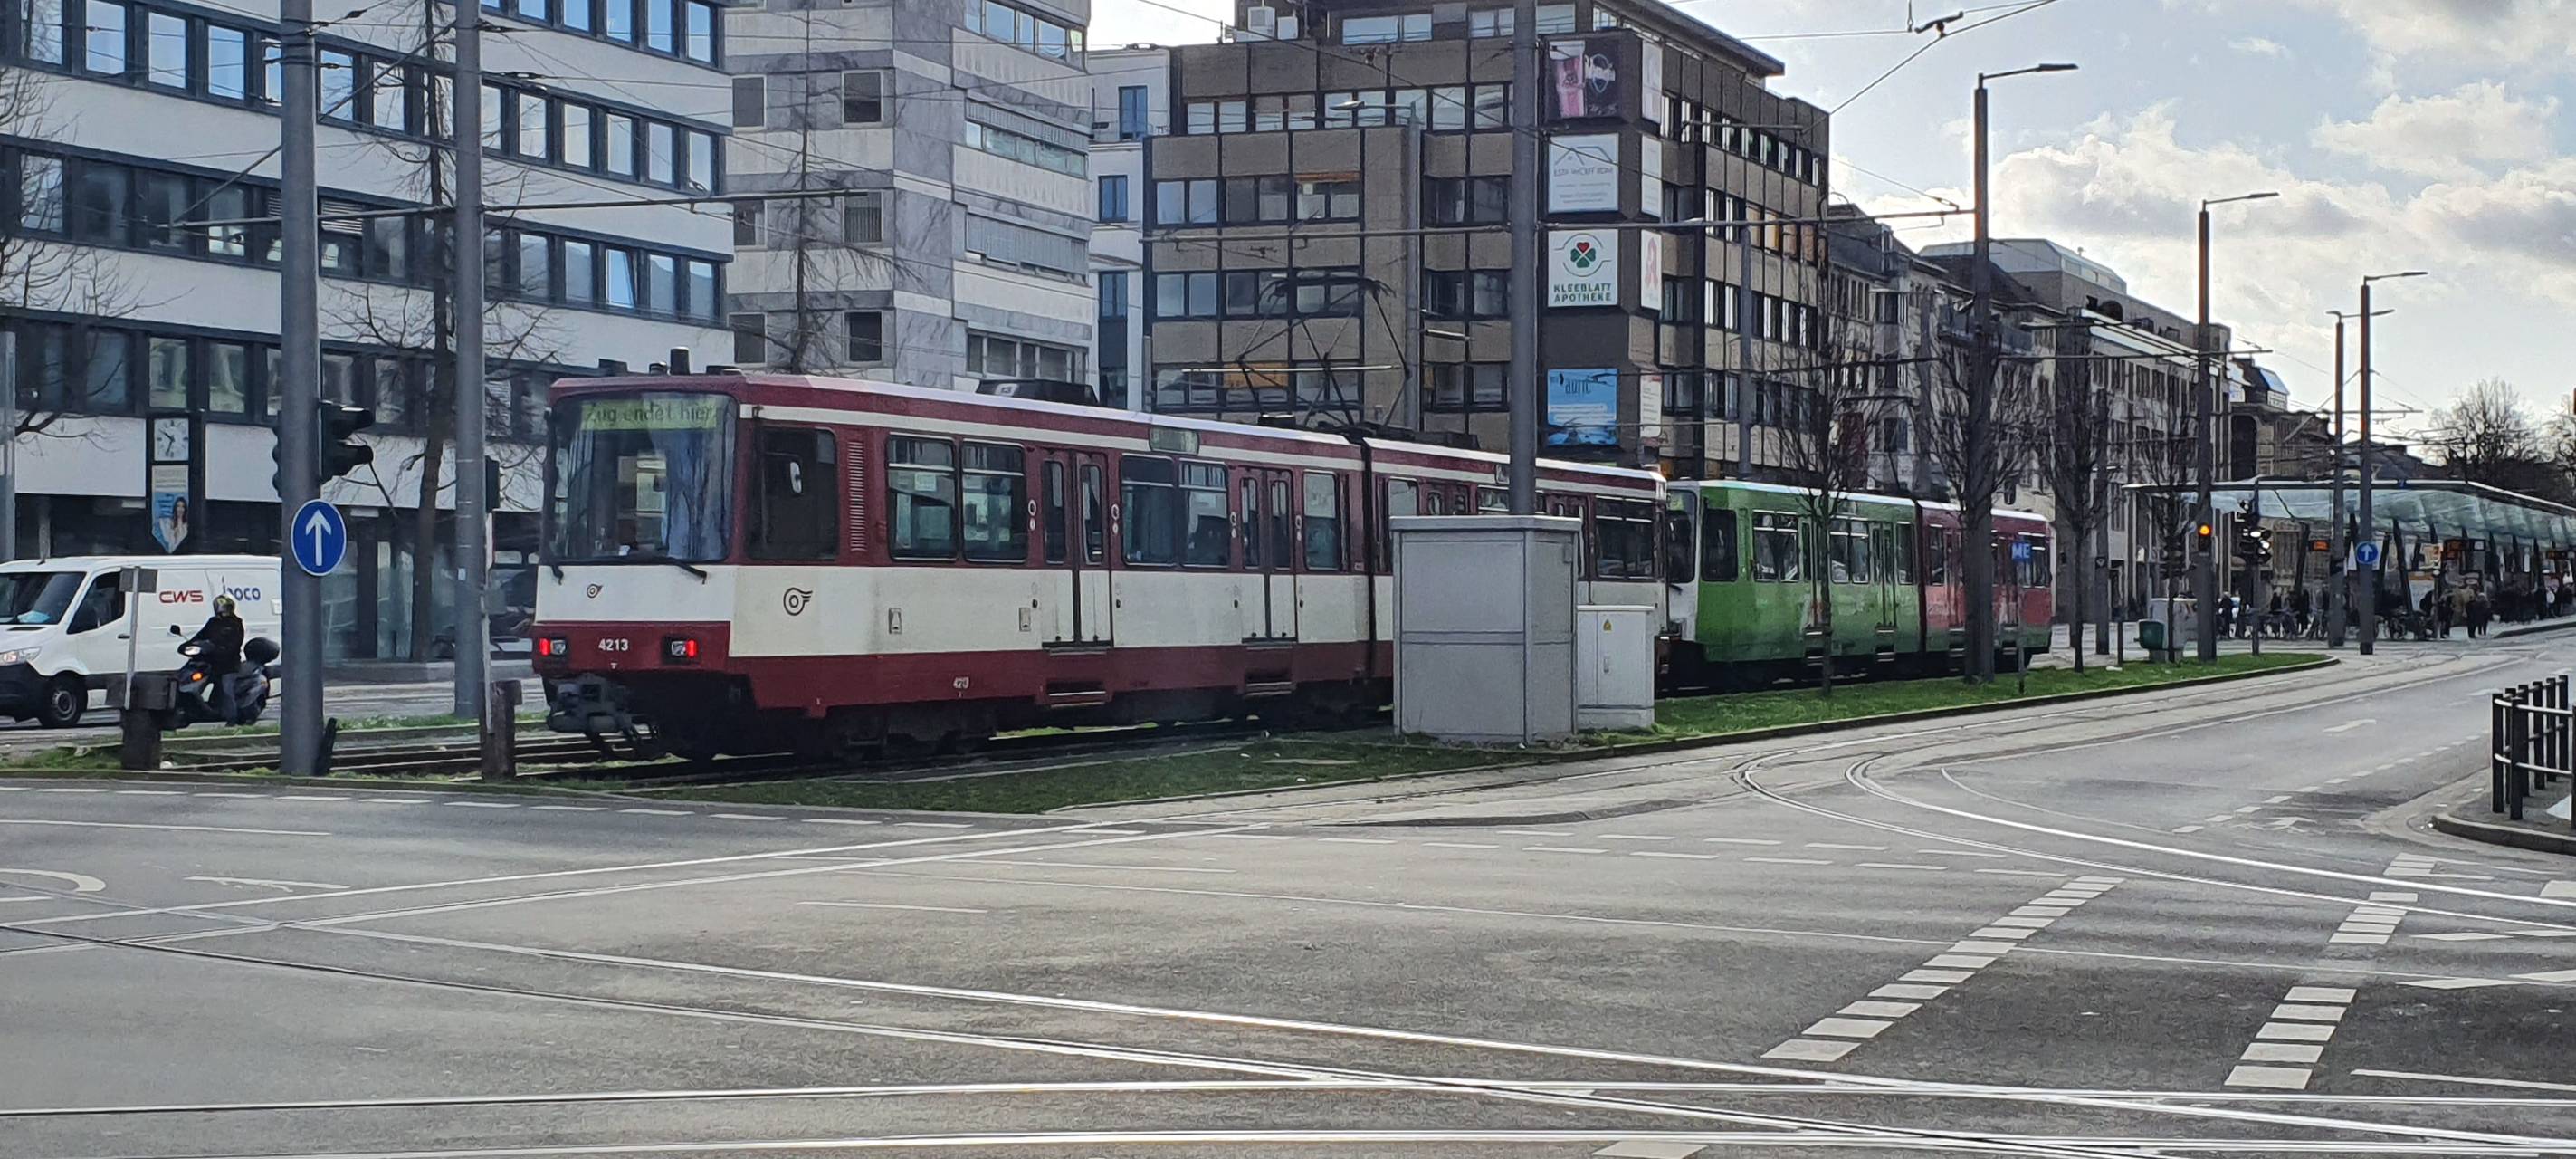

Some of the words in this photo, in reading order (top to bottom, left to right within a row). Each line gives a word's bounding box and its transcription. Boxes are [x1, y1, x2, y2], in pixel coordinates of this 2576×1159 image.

[1553, 283, 1611, 292] KLEEBLATT
[1554, 292, 1611, 302] APOTHEKE
[587, 403, 617, 426] Zug
[624, 400, 671, 421] endet
[680, 400, 713, 421] hier
[159, 590, 204, 604] CWS
[598, 638, 629, 651] 4213
